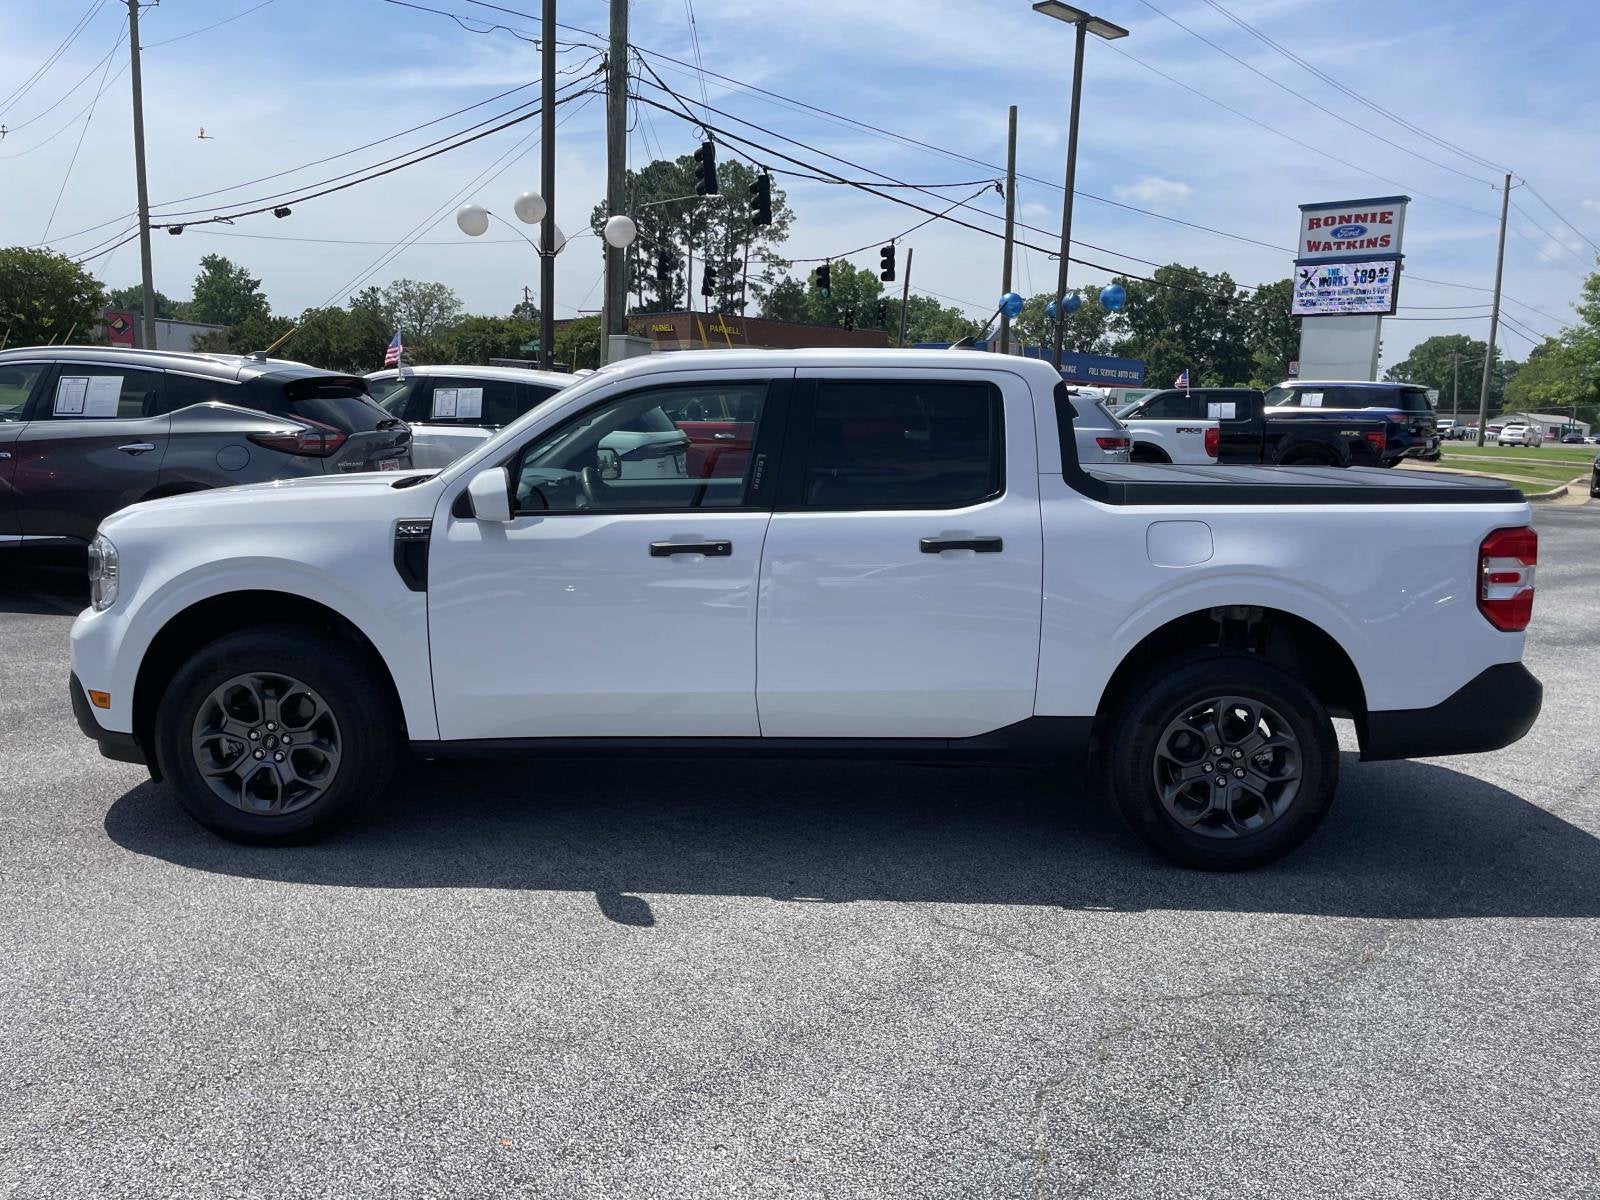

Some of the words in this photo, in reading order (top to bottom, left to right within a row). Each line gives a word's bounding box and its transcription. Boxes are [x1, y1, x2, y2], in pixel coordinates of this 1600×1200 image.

[1308, 211, 1394, 231] RONNIE
[1336, 227, 1361, 238] Ford
[1306, 234, 1392, 252] WATKINS
[1327, 268, 1340, 276] THE
[1318, 275, 1349, 288] WORKS
[651, 324, 674, 333] PARNELL
[1088, 367, 1099, 376] FULL
[1099, 369, 1117, 378] SERVICE
[1118, 370, 1128, 378] AUTO
[1129, 371, 1140, 380] CARE
[399, 526, 430, 534] XLT
